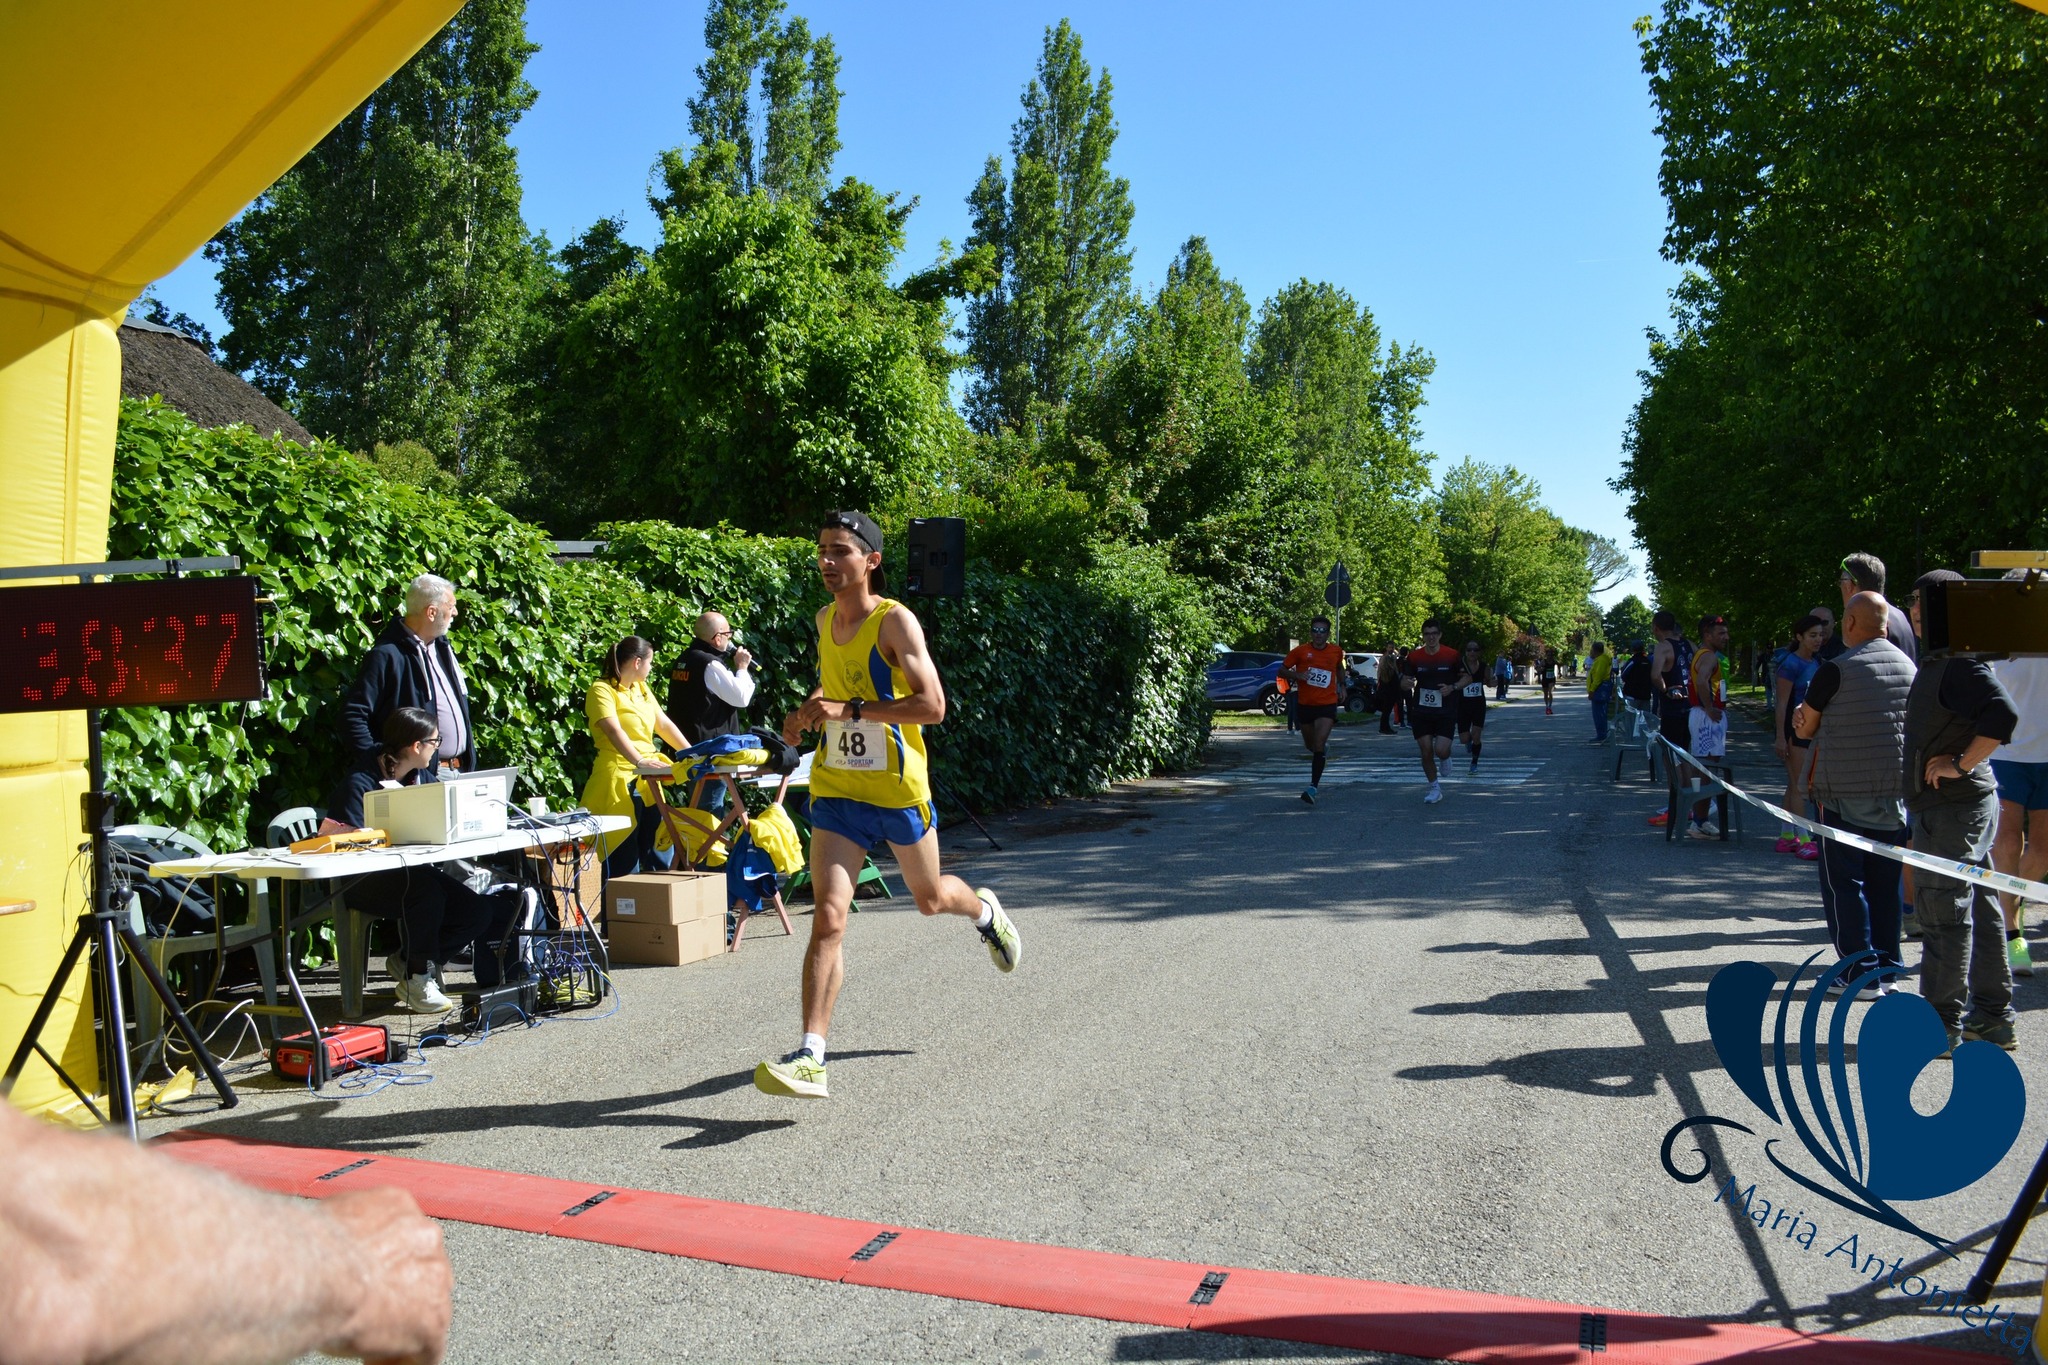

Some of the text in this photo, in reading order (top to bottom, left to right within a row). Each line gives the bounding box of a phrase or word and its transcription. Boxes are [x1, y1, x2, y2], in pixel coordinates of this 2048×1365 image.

[1310, 672, 1328, 684] 252
[1466, 686, 1480, 694] 149
[1424, 693, 1436, 703] 59
[838, 731, 867, 757] 48
